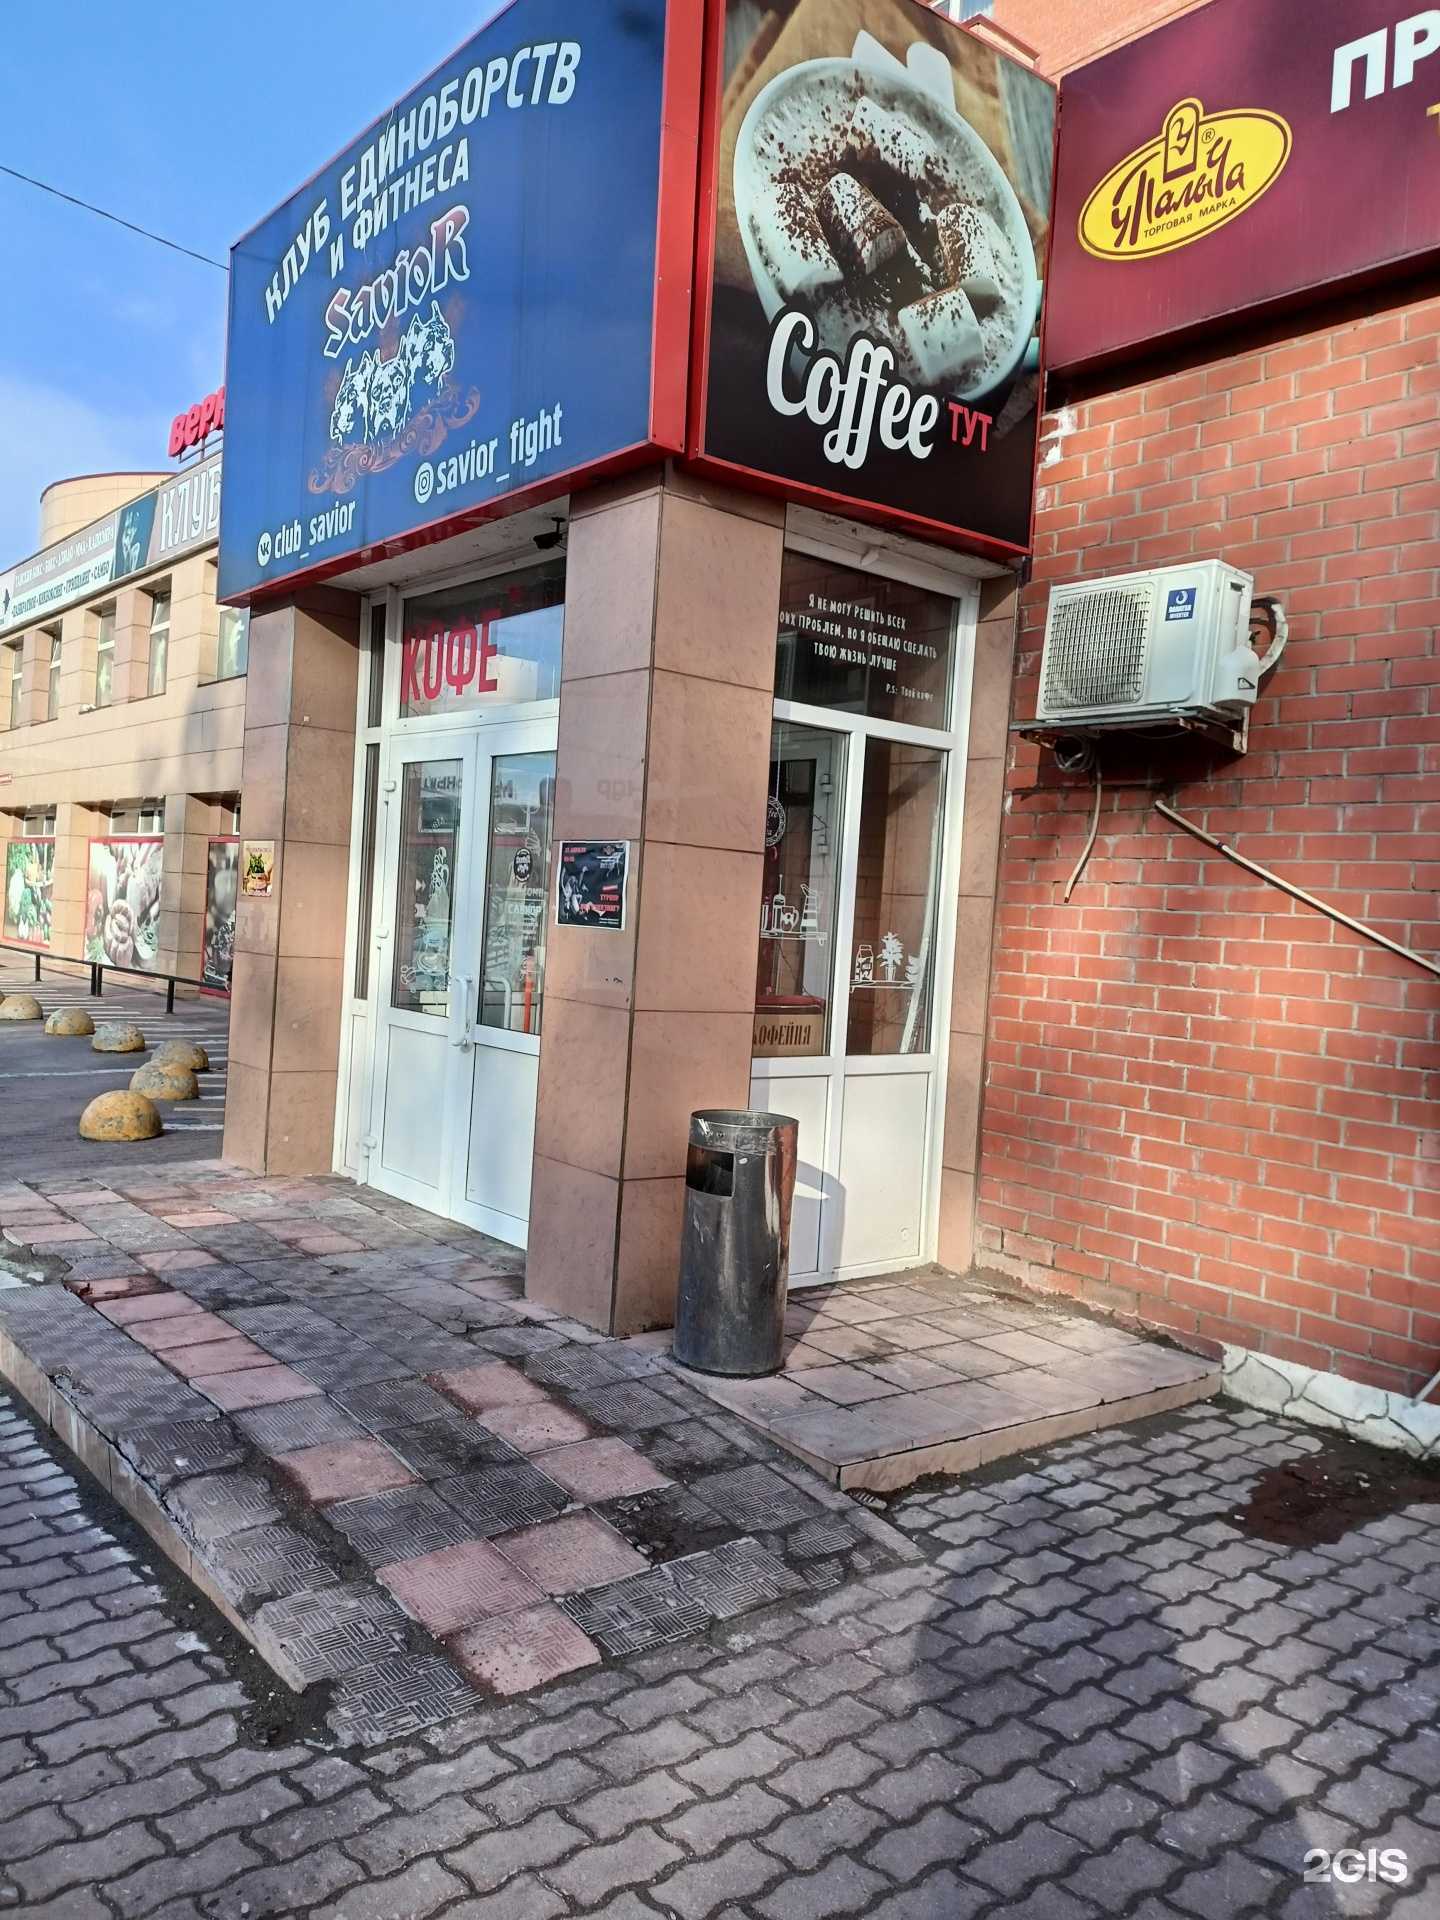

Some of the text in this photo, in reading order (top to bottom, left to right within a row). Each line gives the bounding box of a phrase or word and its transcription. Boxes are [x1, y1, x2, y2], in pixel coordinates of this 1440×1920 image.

[265, 42, 581, 324] КЛУБ ЕДИНОБОРСТВ
[330, 138, 469, 279] И ФИТНЕСА
[1144, 196, 1237, 239] ТОРГОВАЯ МАРКА
[766, 311, 939, 470] Coffee
[275, 500, 356, 559] club_savior
[808, 593, 906, 631] Я НЕ МОГУ РЕШИТЬ ВСЕХ
[400, 608, 502, 705] КОФЕ
[814, 641, 897, 672] ТВОЮ ЖИЗНЬ ЛУЧШЕ
[847, 626, 858, 641] НО
[867, 631, 901, 652] ОБЕЩАЮ
[903, 640, 937, 660] СДЕЛАТЬ
